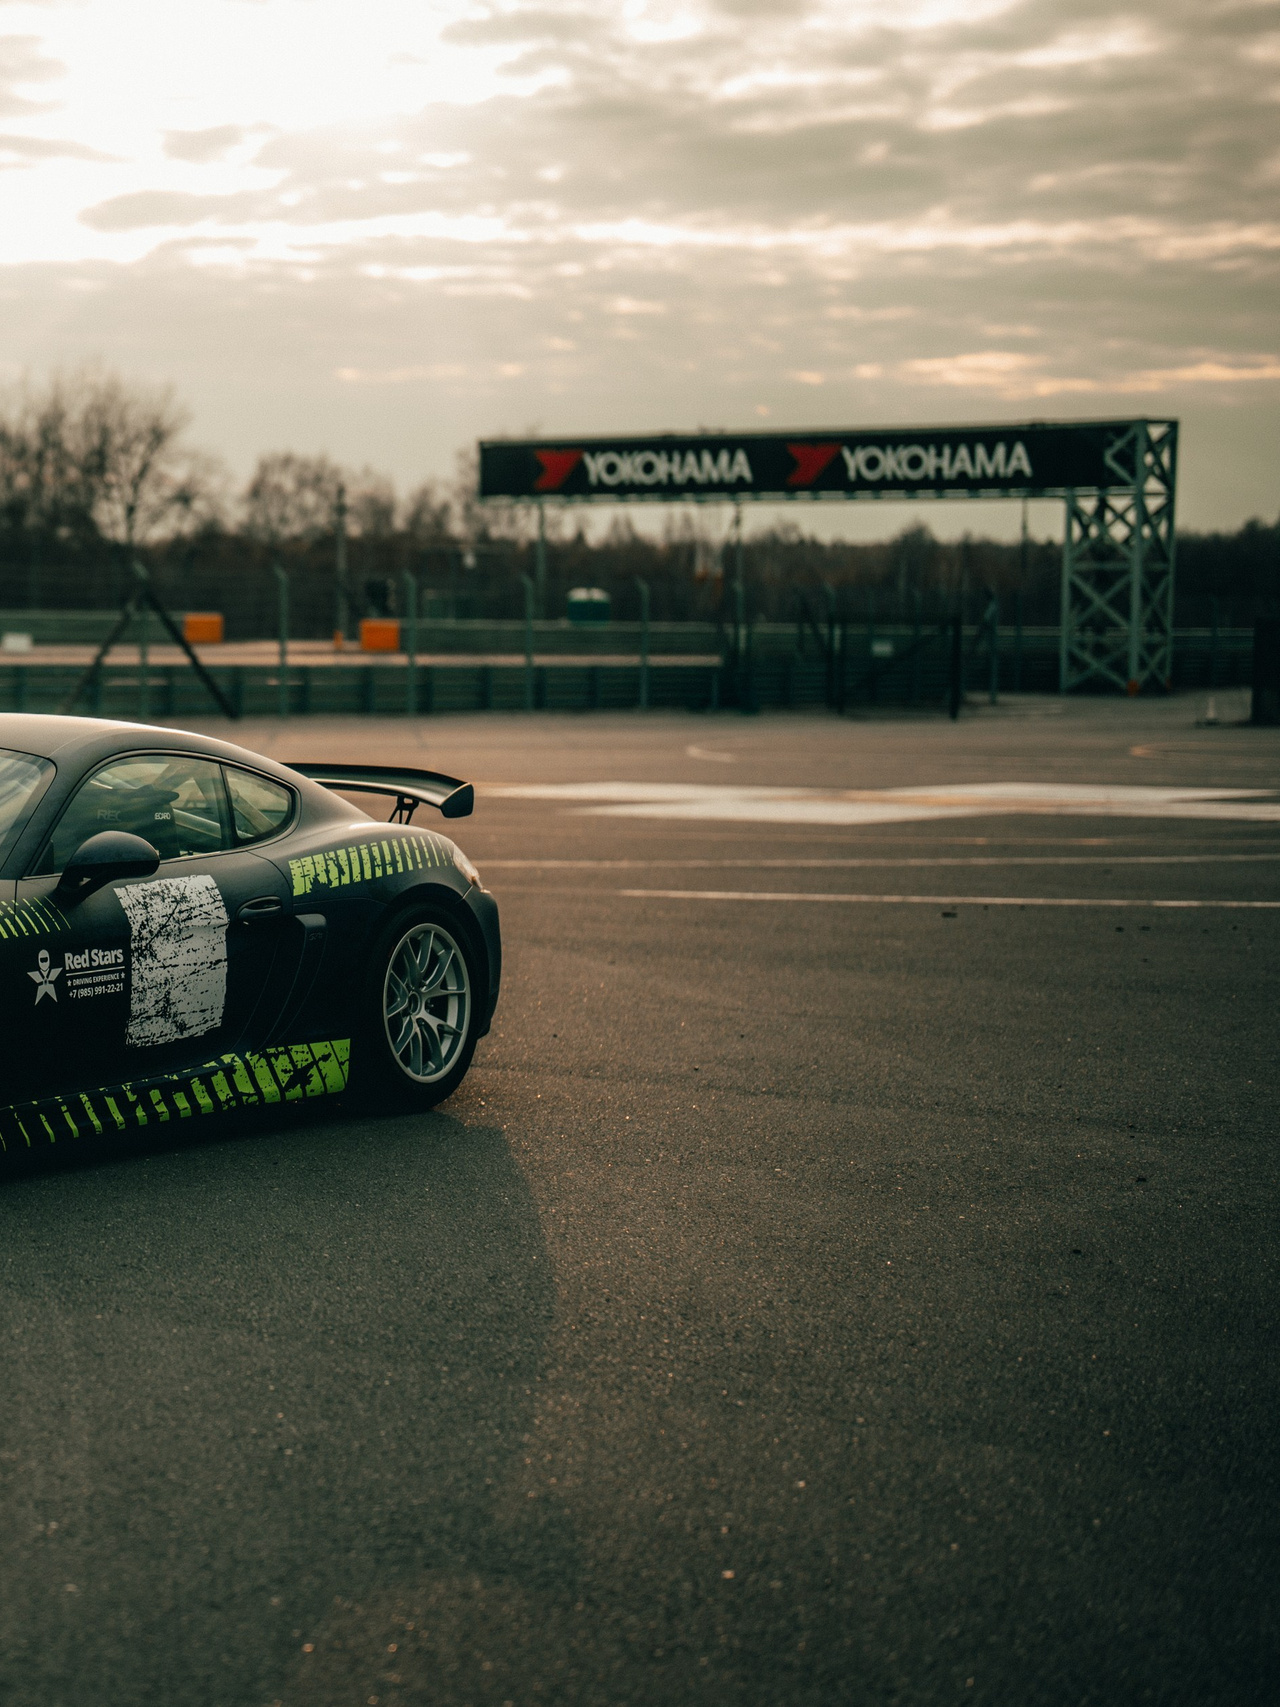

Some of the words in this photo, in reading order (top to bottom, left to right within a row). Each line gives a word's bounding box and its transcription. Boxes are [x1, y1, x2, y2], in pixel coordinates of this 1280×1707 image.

[583, 449, 754, 486] YOKOHAMA
[842, 442, 1033, 482] YOKOHAMA
[64, 949, 90, 970] Red
[91, 948, 124, 967] Stars
[72, 976, 92, 985] DRIVING
[93, 973, 120, 982] EXPERIENCE
[69, 989, 77, 999] +7
[94, 983, 123, 995] 991-22-21
